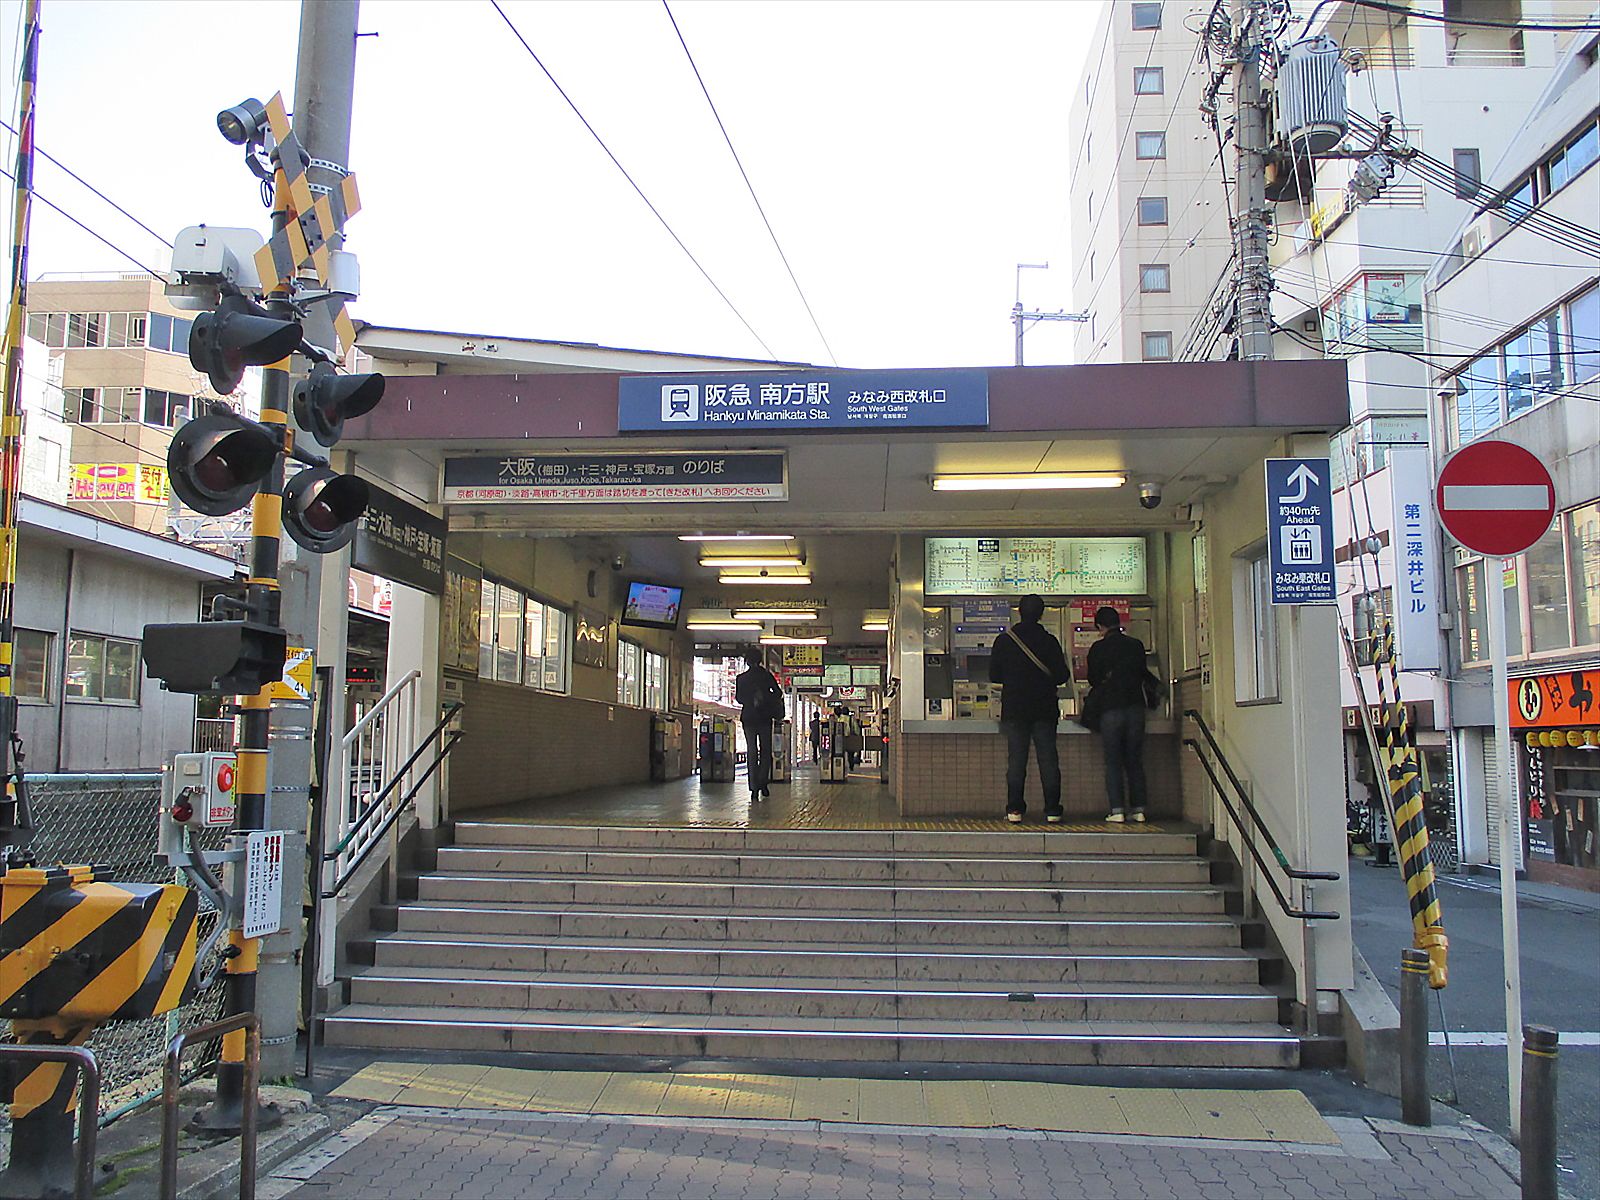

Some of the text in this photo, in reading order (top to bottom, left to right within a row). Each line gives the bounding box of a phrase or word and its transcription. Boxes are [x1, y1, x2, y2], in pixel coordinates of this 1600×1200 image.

[704, 383, 830, 406] 阪急 南方駅
[847, 390, 946, 404] みなみ西改札口
[704, 408, 830, 423] Hankyu Minamikata Sta.
[847, 405, 867, 413] South
[887, 404, 908, 412] Gates
[682, 460, 725, 474] のりば
[141, 466, 162, 486] 受付
[499, 477, 508, 485] for
[510, 477, 533, 485] Osaka
[75, 479, 135, 499] Heaven
[1279, 506, 1321, 516] 約40m先
[1286, 516, 1315, 524] Ahead
[1404, 503, 1427, 613] 第二深井ビル
[1275, 572, 1330, 584] みなみ東改札口
